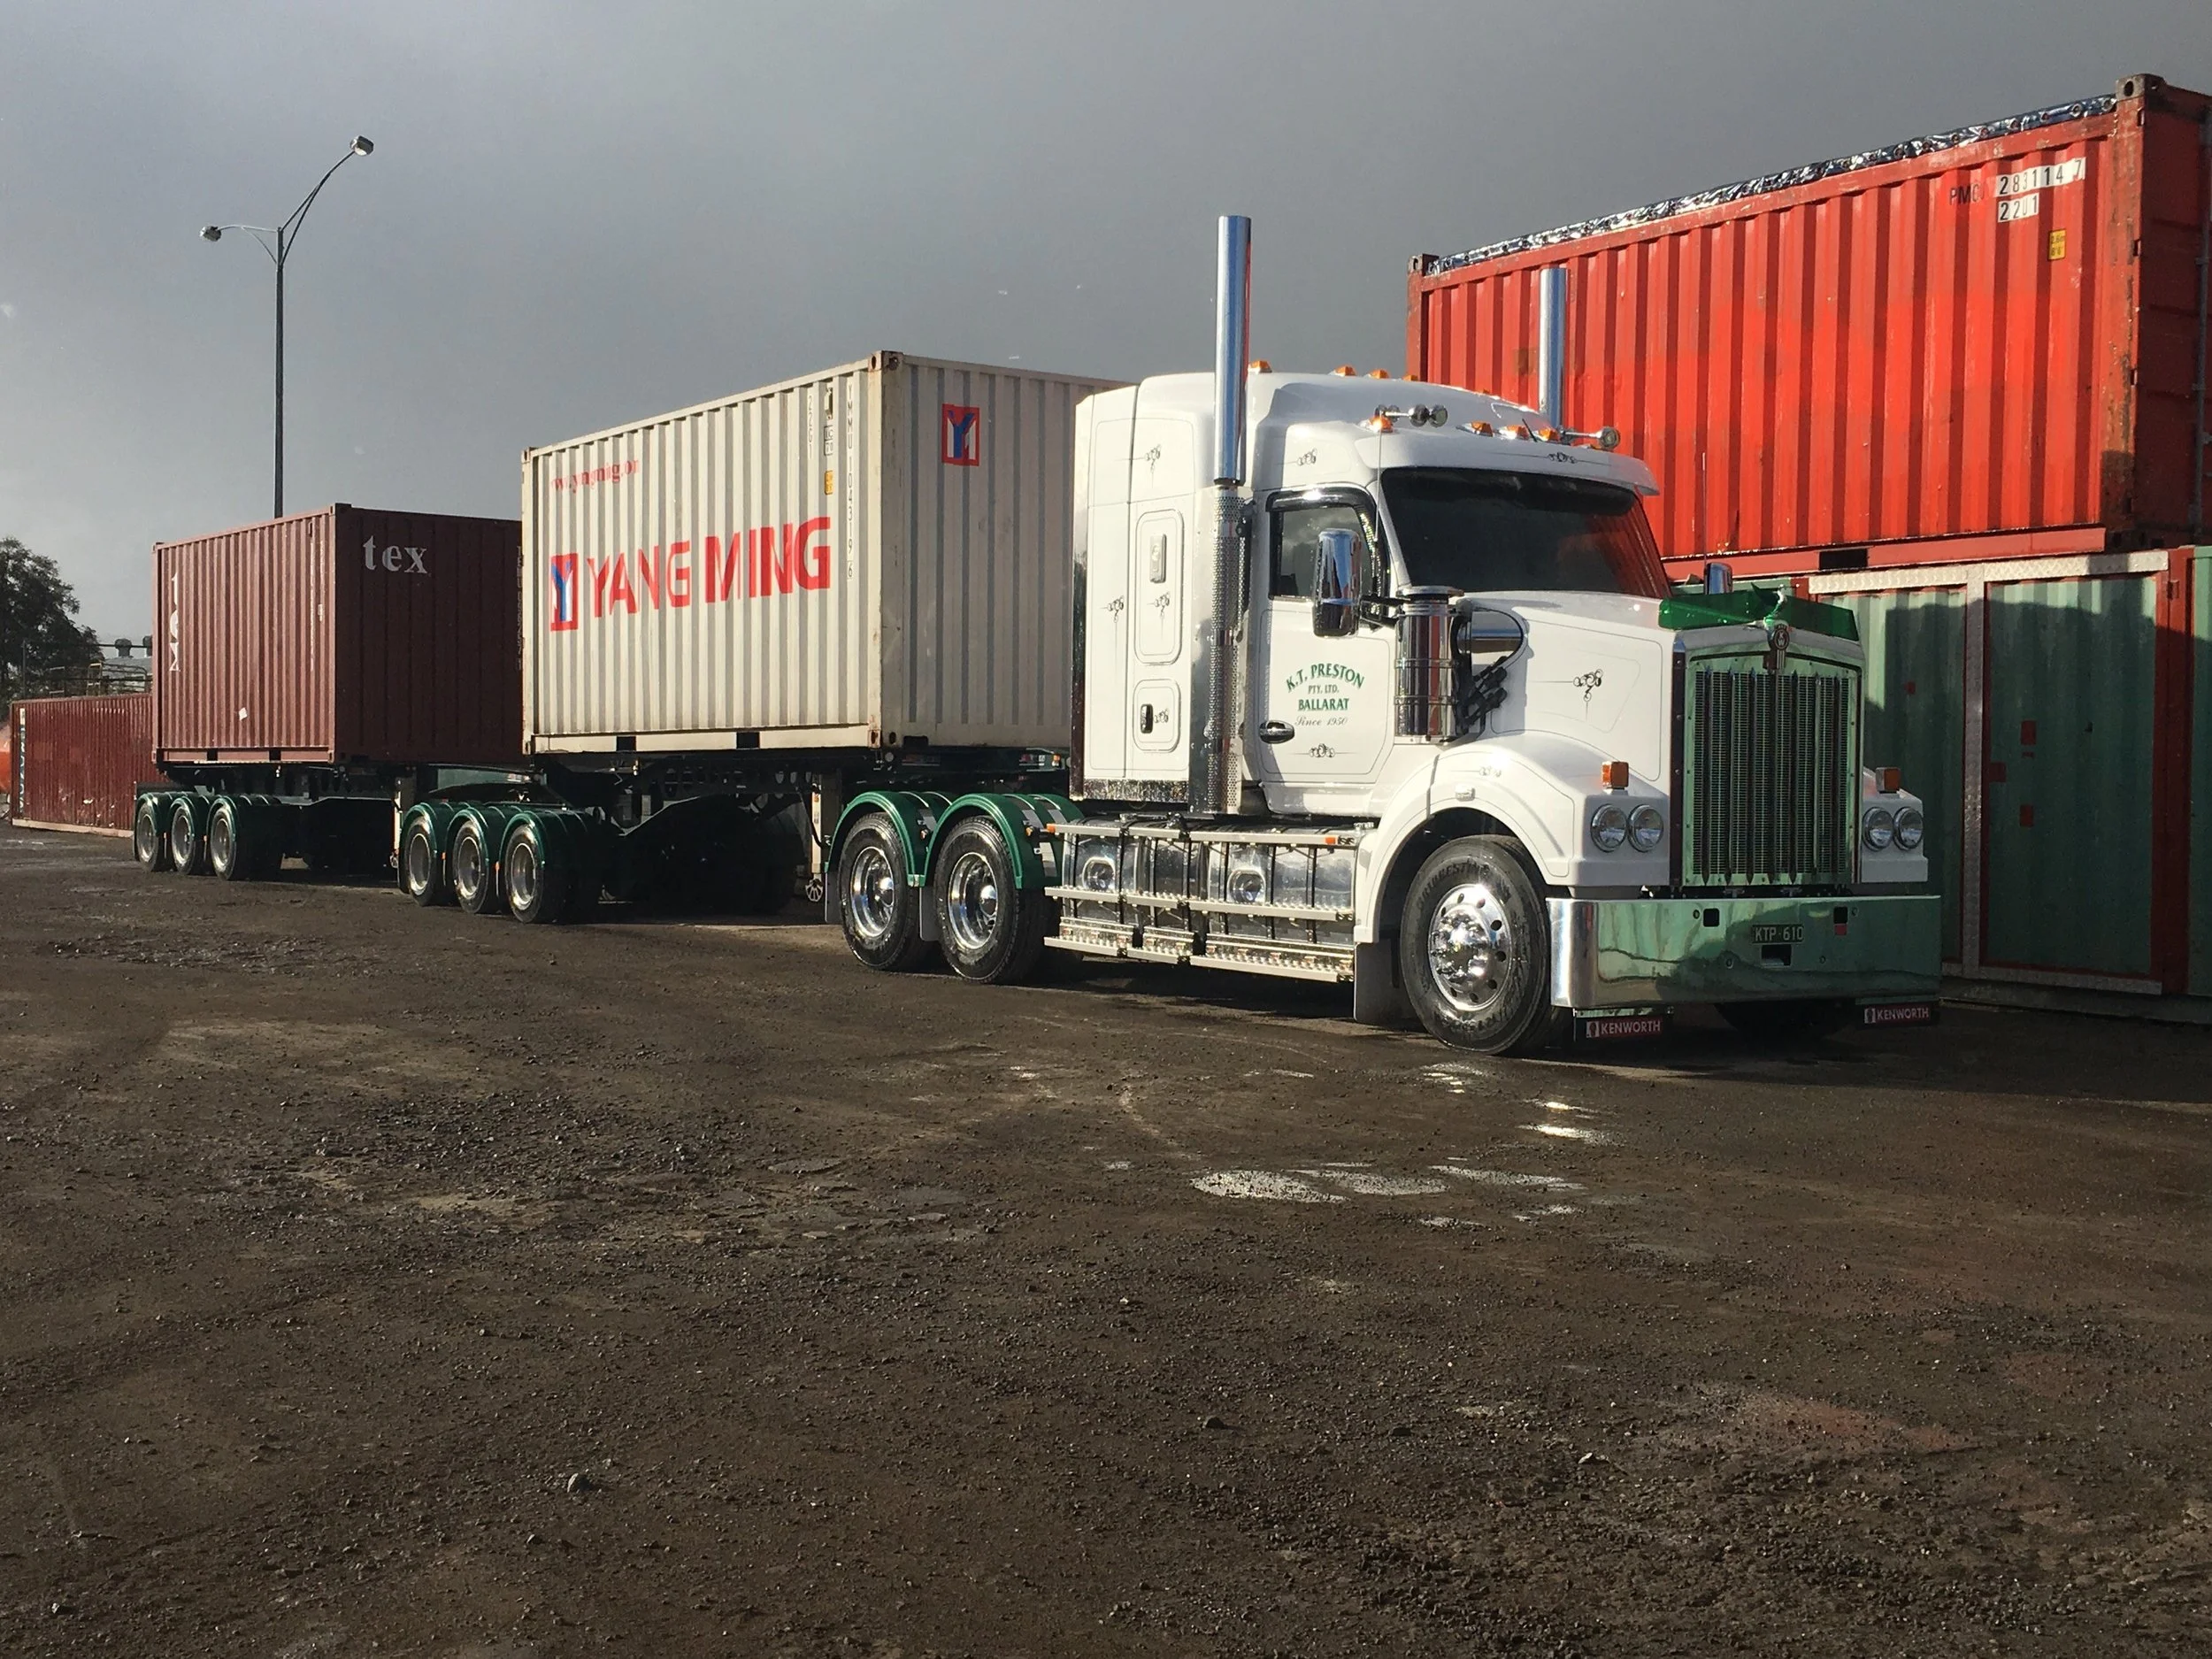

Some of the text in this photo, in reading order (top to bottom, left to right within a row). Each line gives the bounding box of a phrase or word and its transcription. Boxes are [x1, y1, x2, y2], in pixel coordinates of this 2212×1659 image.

[362, 534, 428, 574] tex
[587, 541, 690, 618] YANG
[705, 517, 830, 603] MING
[1310, 663, 1365, 689] PRESTON
[1308, 684, 1340, 695] PTY. LTD.
[1297, 698, 1349, 711] BALLARAT
[1877, 1007, 1930, 1020] KENWORTH
[1601, 1020, 1661, 1034] KENWORTH
